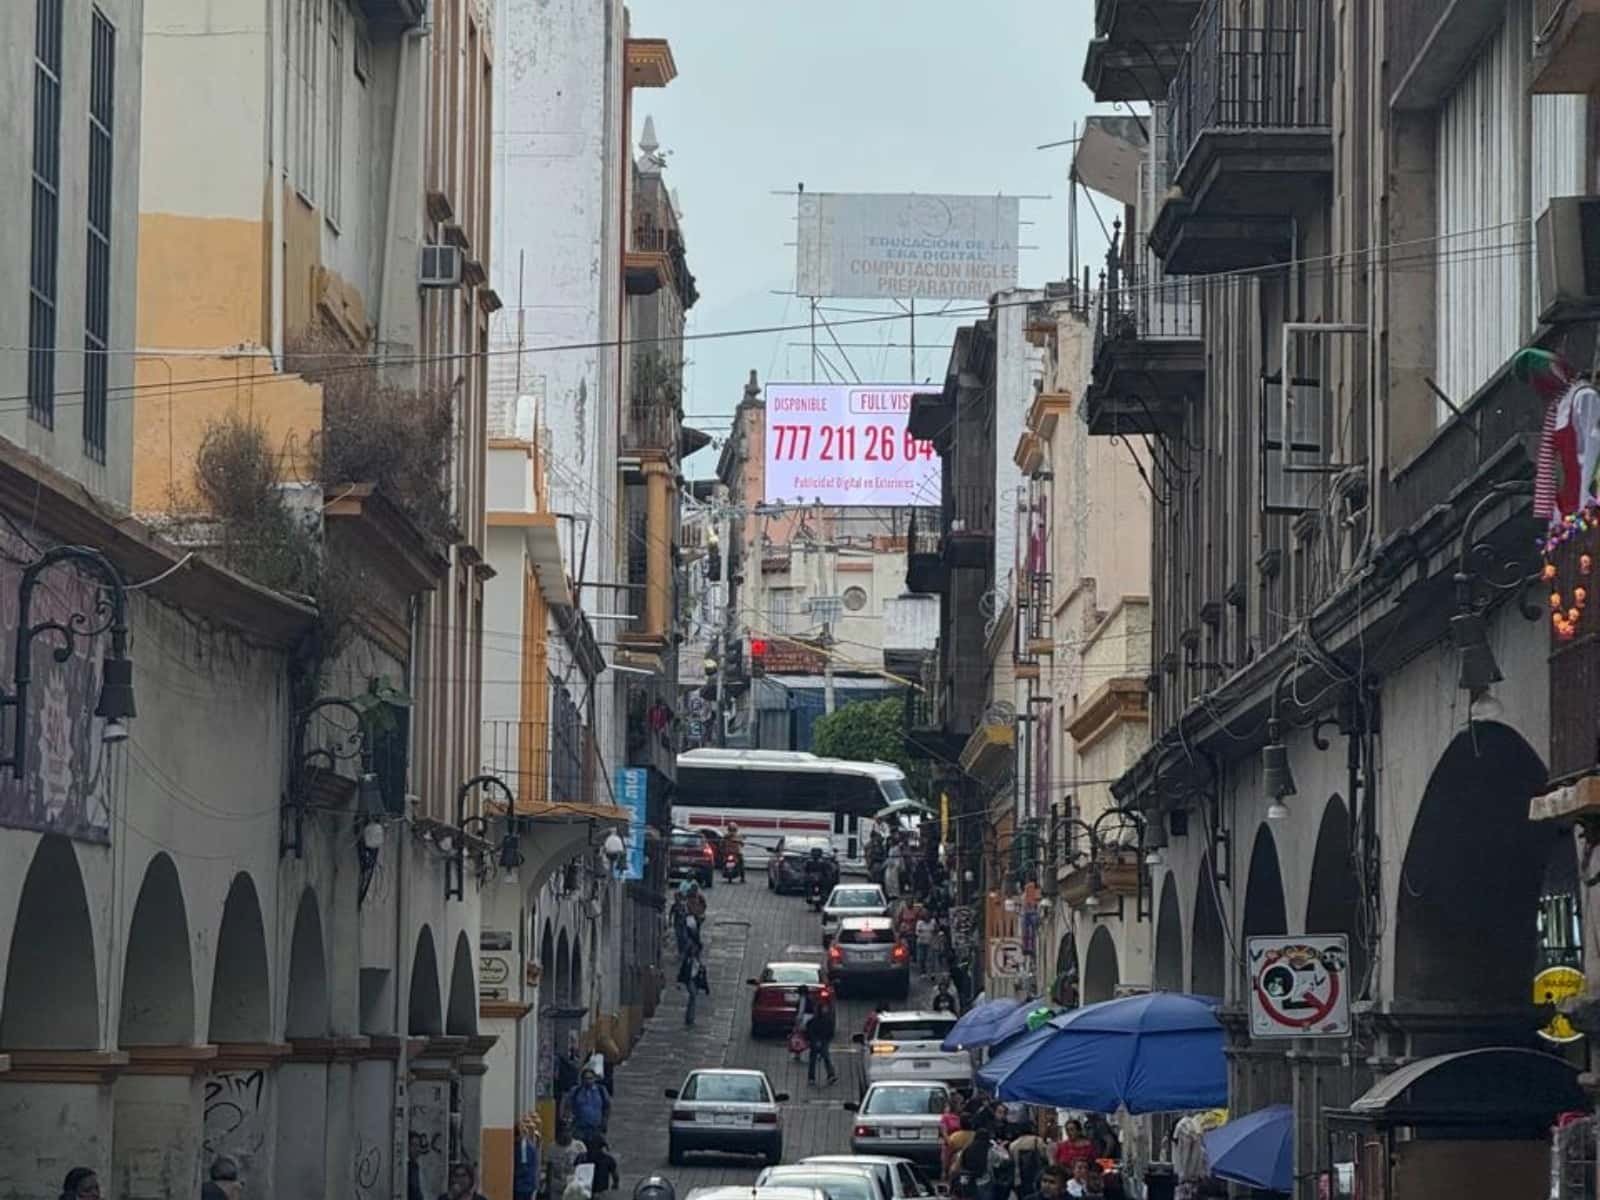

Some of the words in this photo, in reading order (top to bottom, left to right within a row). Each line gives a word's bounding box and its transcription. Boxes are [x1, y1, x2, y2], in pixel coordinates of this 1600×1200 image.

[878, 277, 992, 295] PREPARATORIA
[775, 398, 827, 411] DISPONIBLE
[861, 394, 888, 410] FULL
[891, 394, 911, 410] VIS
[772, 426, 811, 461] 777
[819, 426, 855, 461] 211
[864, 426, 895, 461] 26
[794, 476, 833, 488] Publicidad
[836, 476, 862, 491] Digital
